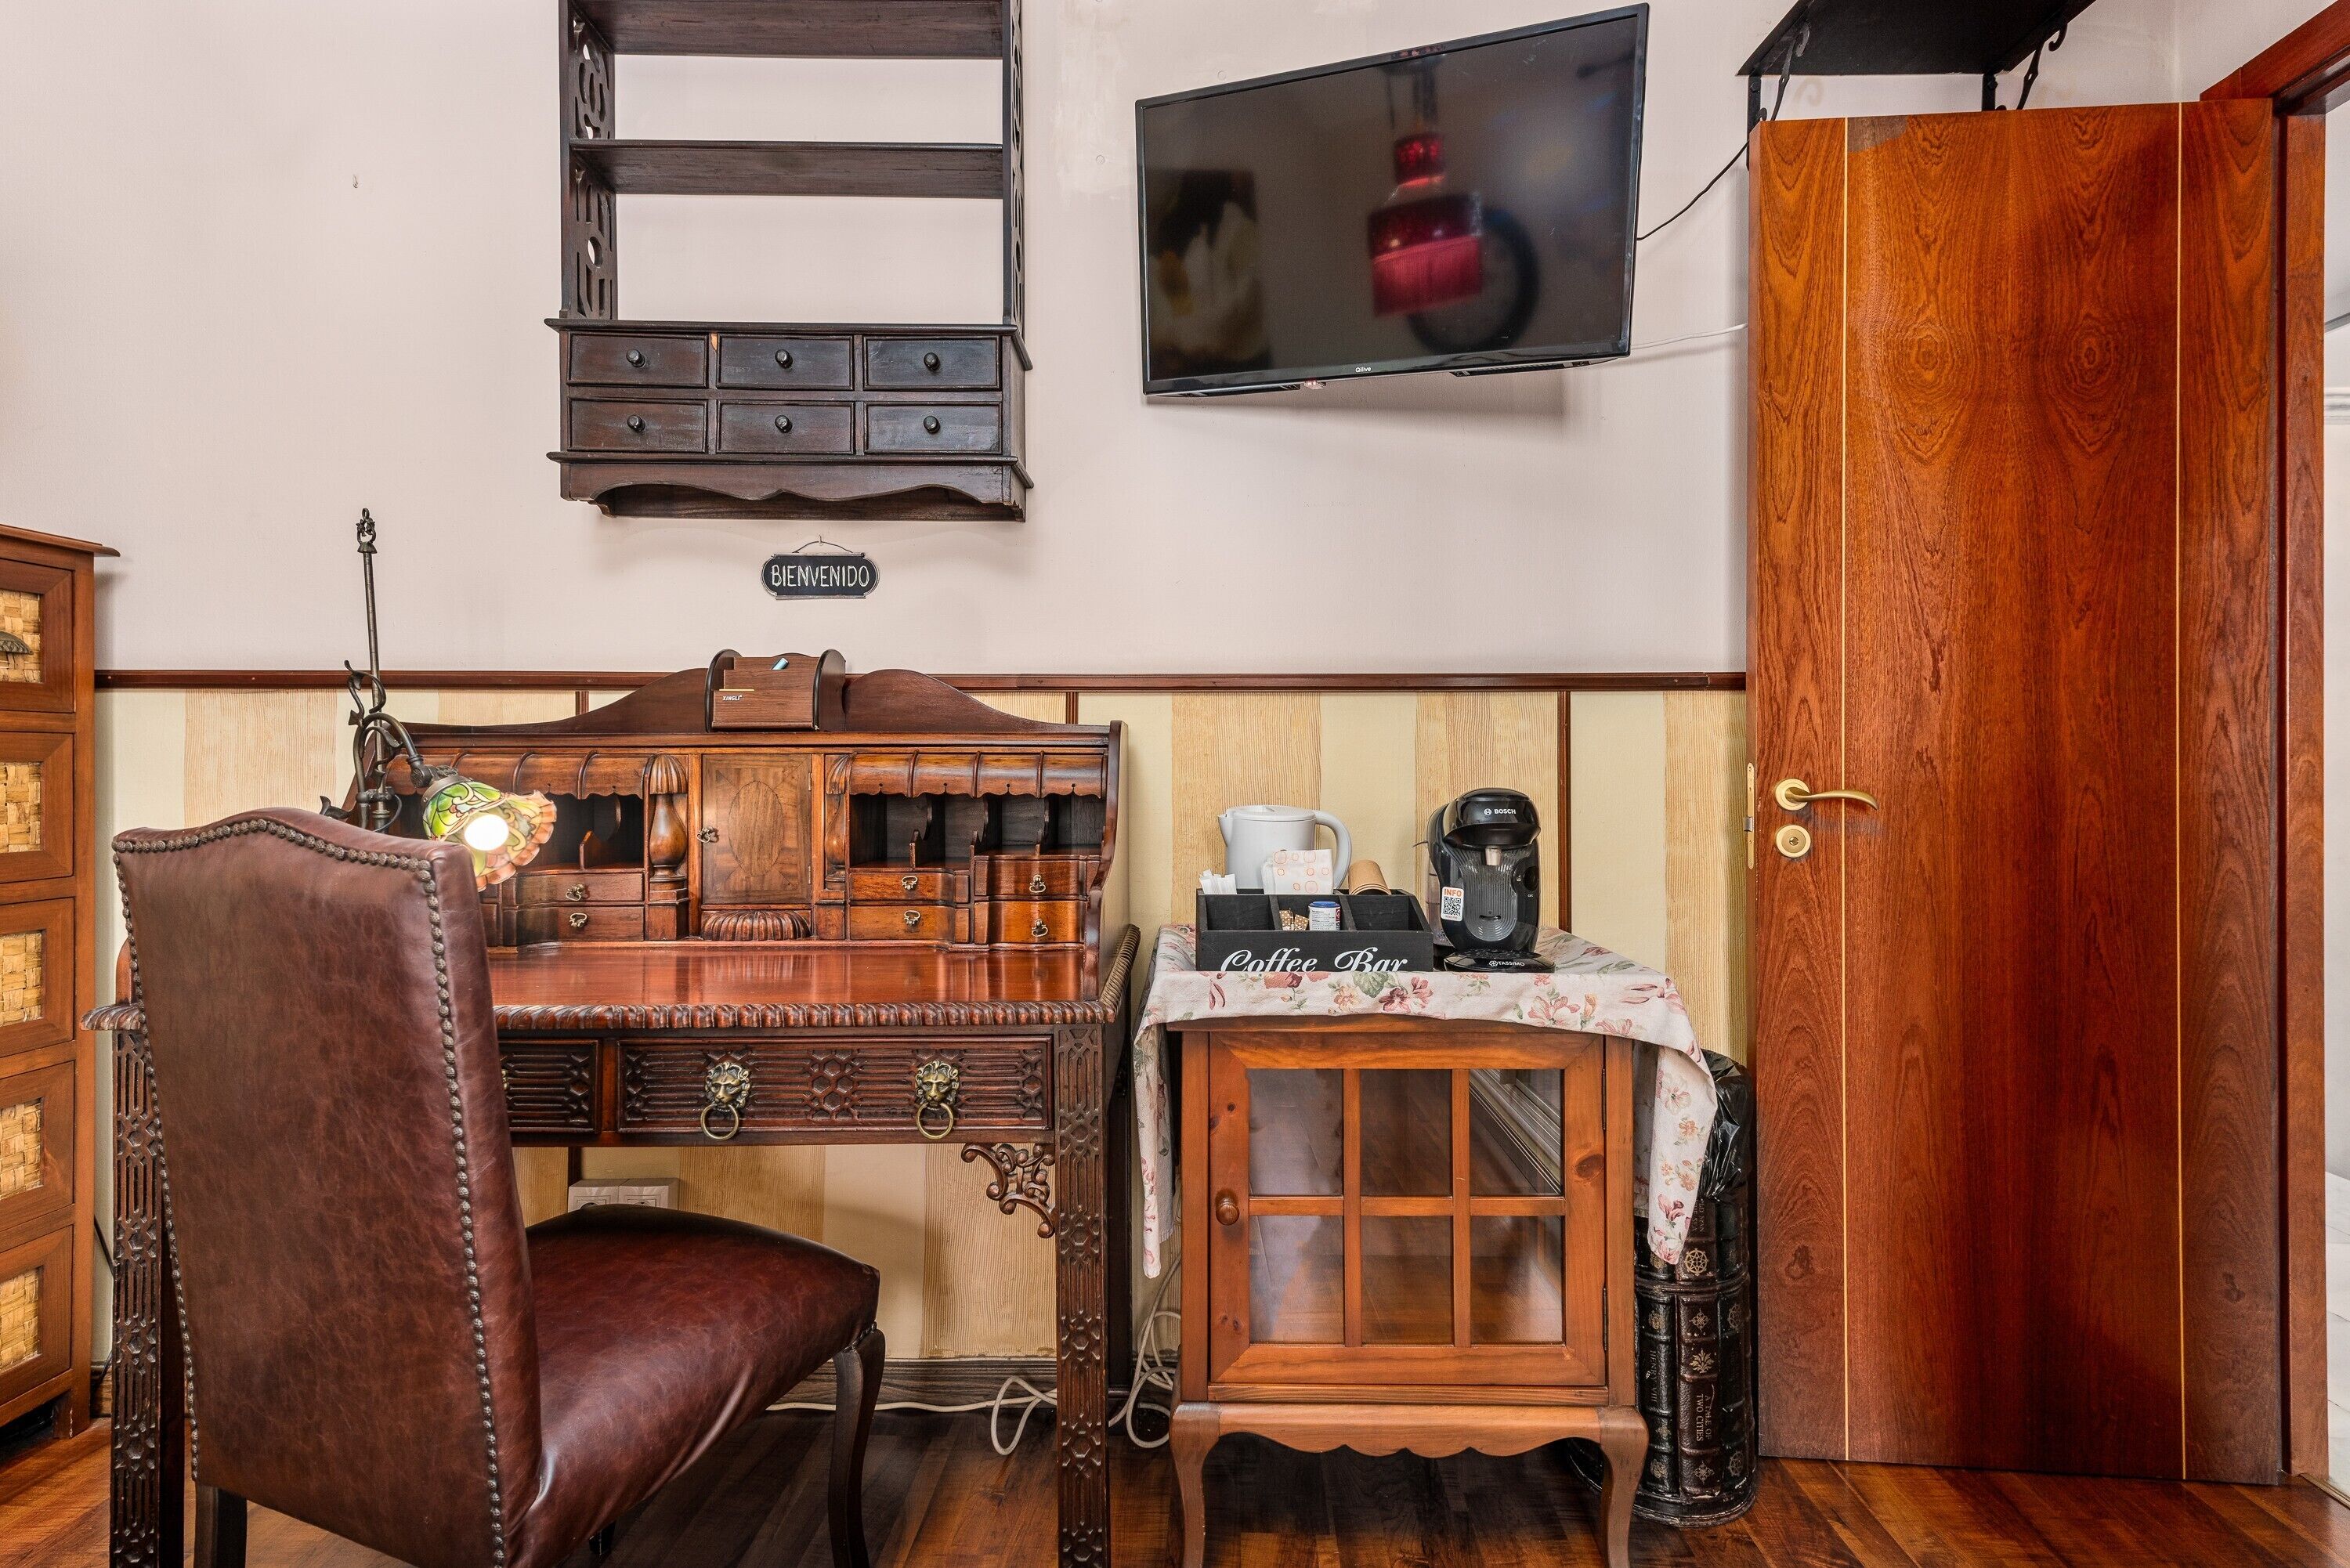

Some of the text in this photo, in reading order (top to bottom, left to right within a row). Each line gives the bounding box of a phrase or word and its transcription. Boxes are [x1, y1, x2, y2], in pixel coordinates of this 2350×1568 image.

[771, 564, 870, 587] BIENVENIDO
[1220, 946, 1408, 973] Coffee Bar
[1705, 1429, 1712, 1440] OF
